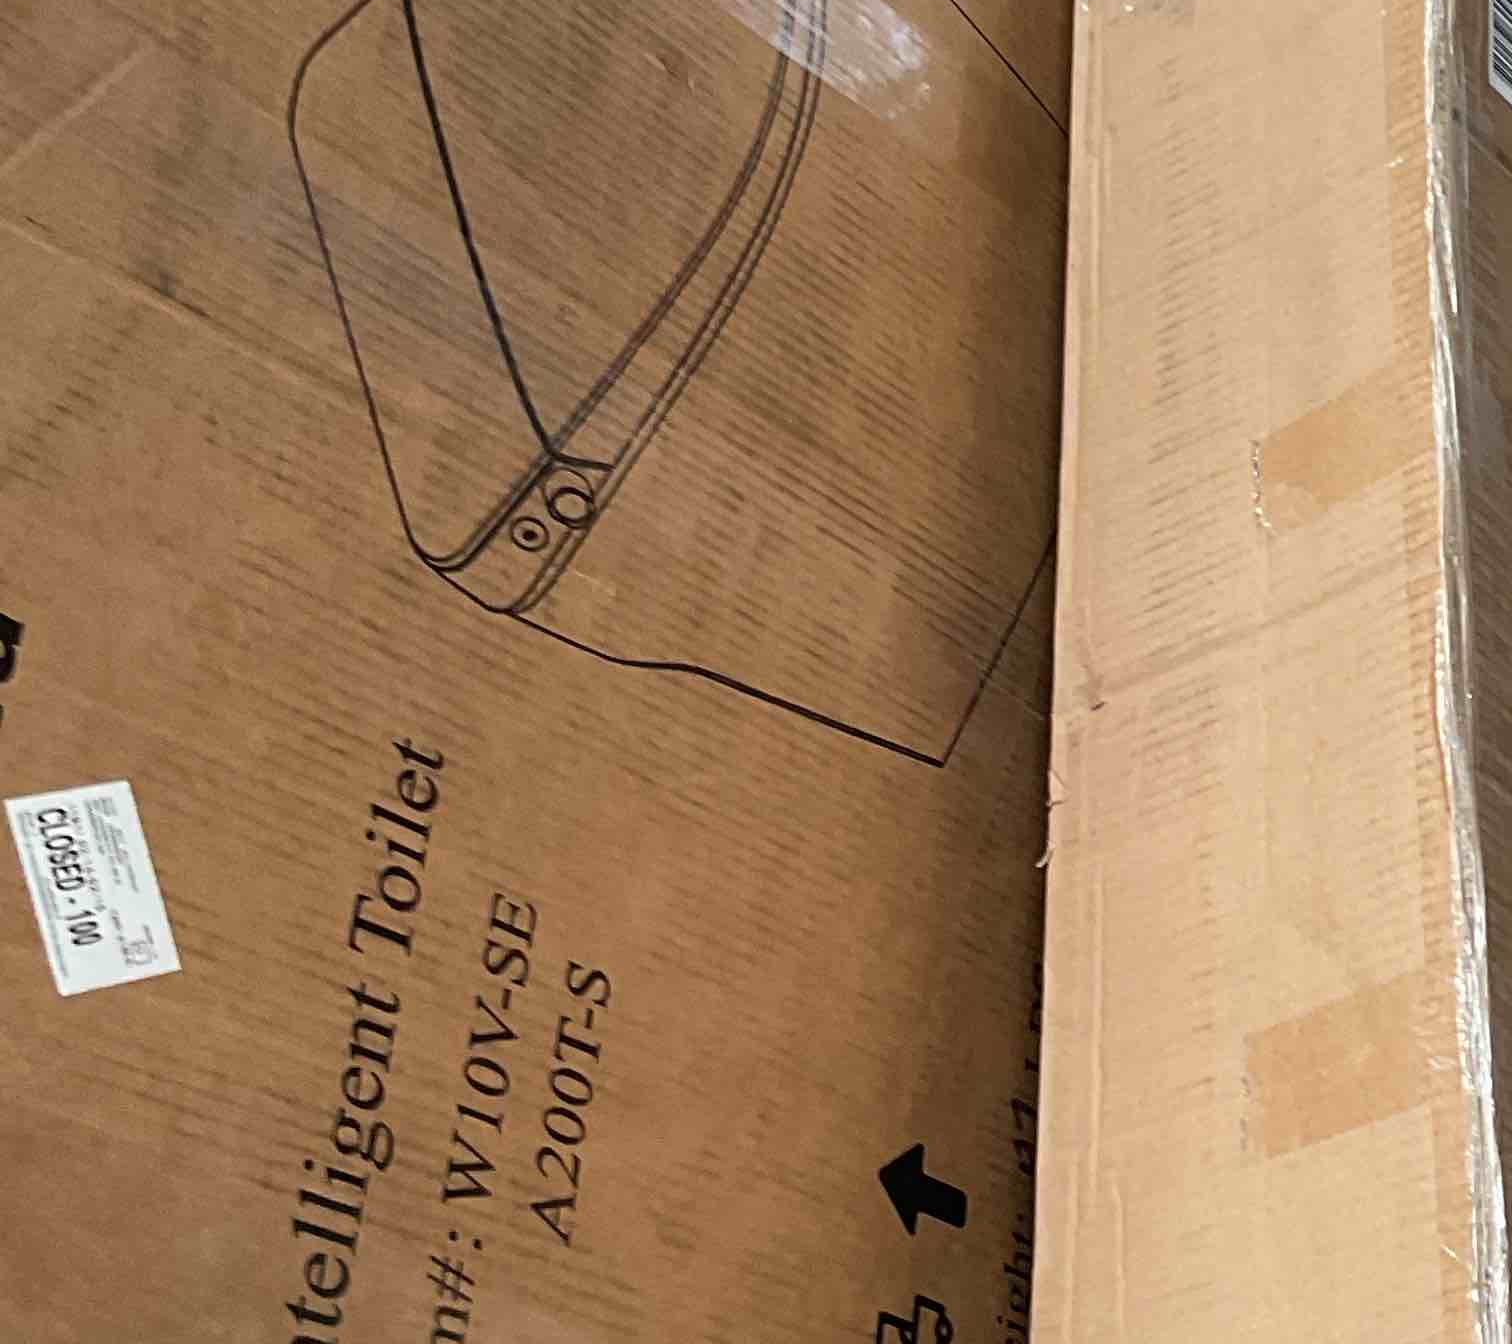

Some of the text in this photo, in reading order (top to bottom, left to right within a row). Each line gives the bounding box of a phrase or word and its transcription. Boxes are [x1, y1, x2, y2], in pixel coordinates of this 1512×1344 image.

[37, 807, 84, 892] CLOSED
[64, 909, 104, 946] 100
[348, 736, 446, 958] Toilet
[443, 892, 538, 1205] W10V-SE
[529, 959, 613, 1249] A200T-S
